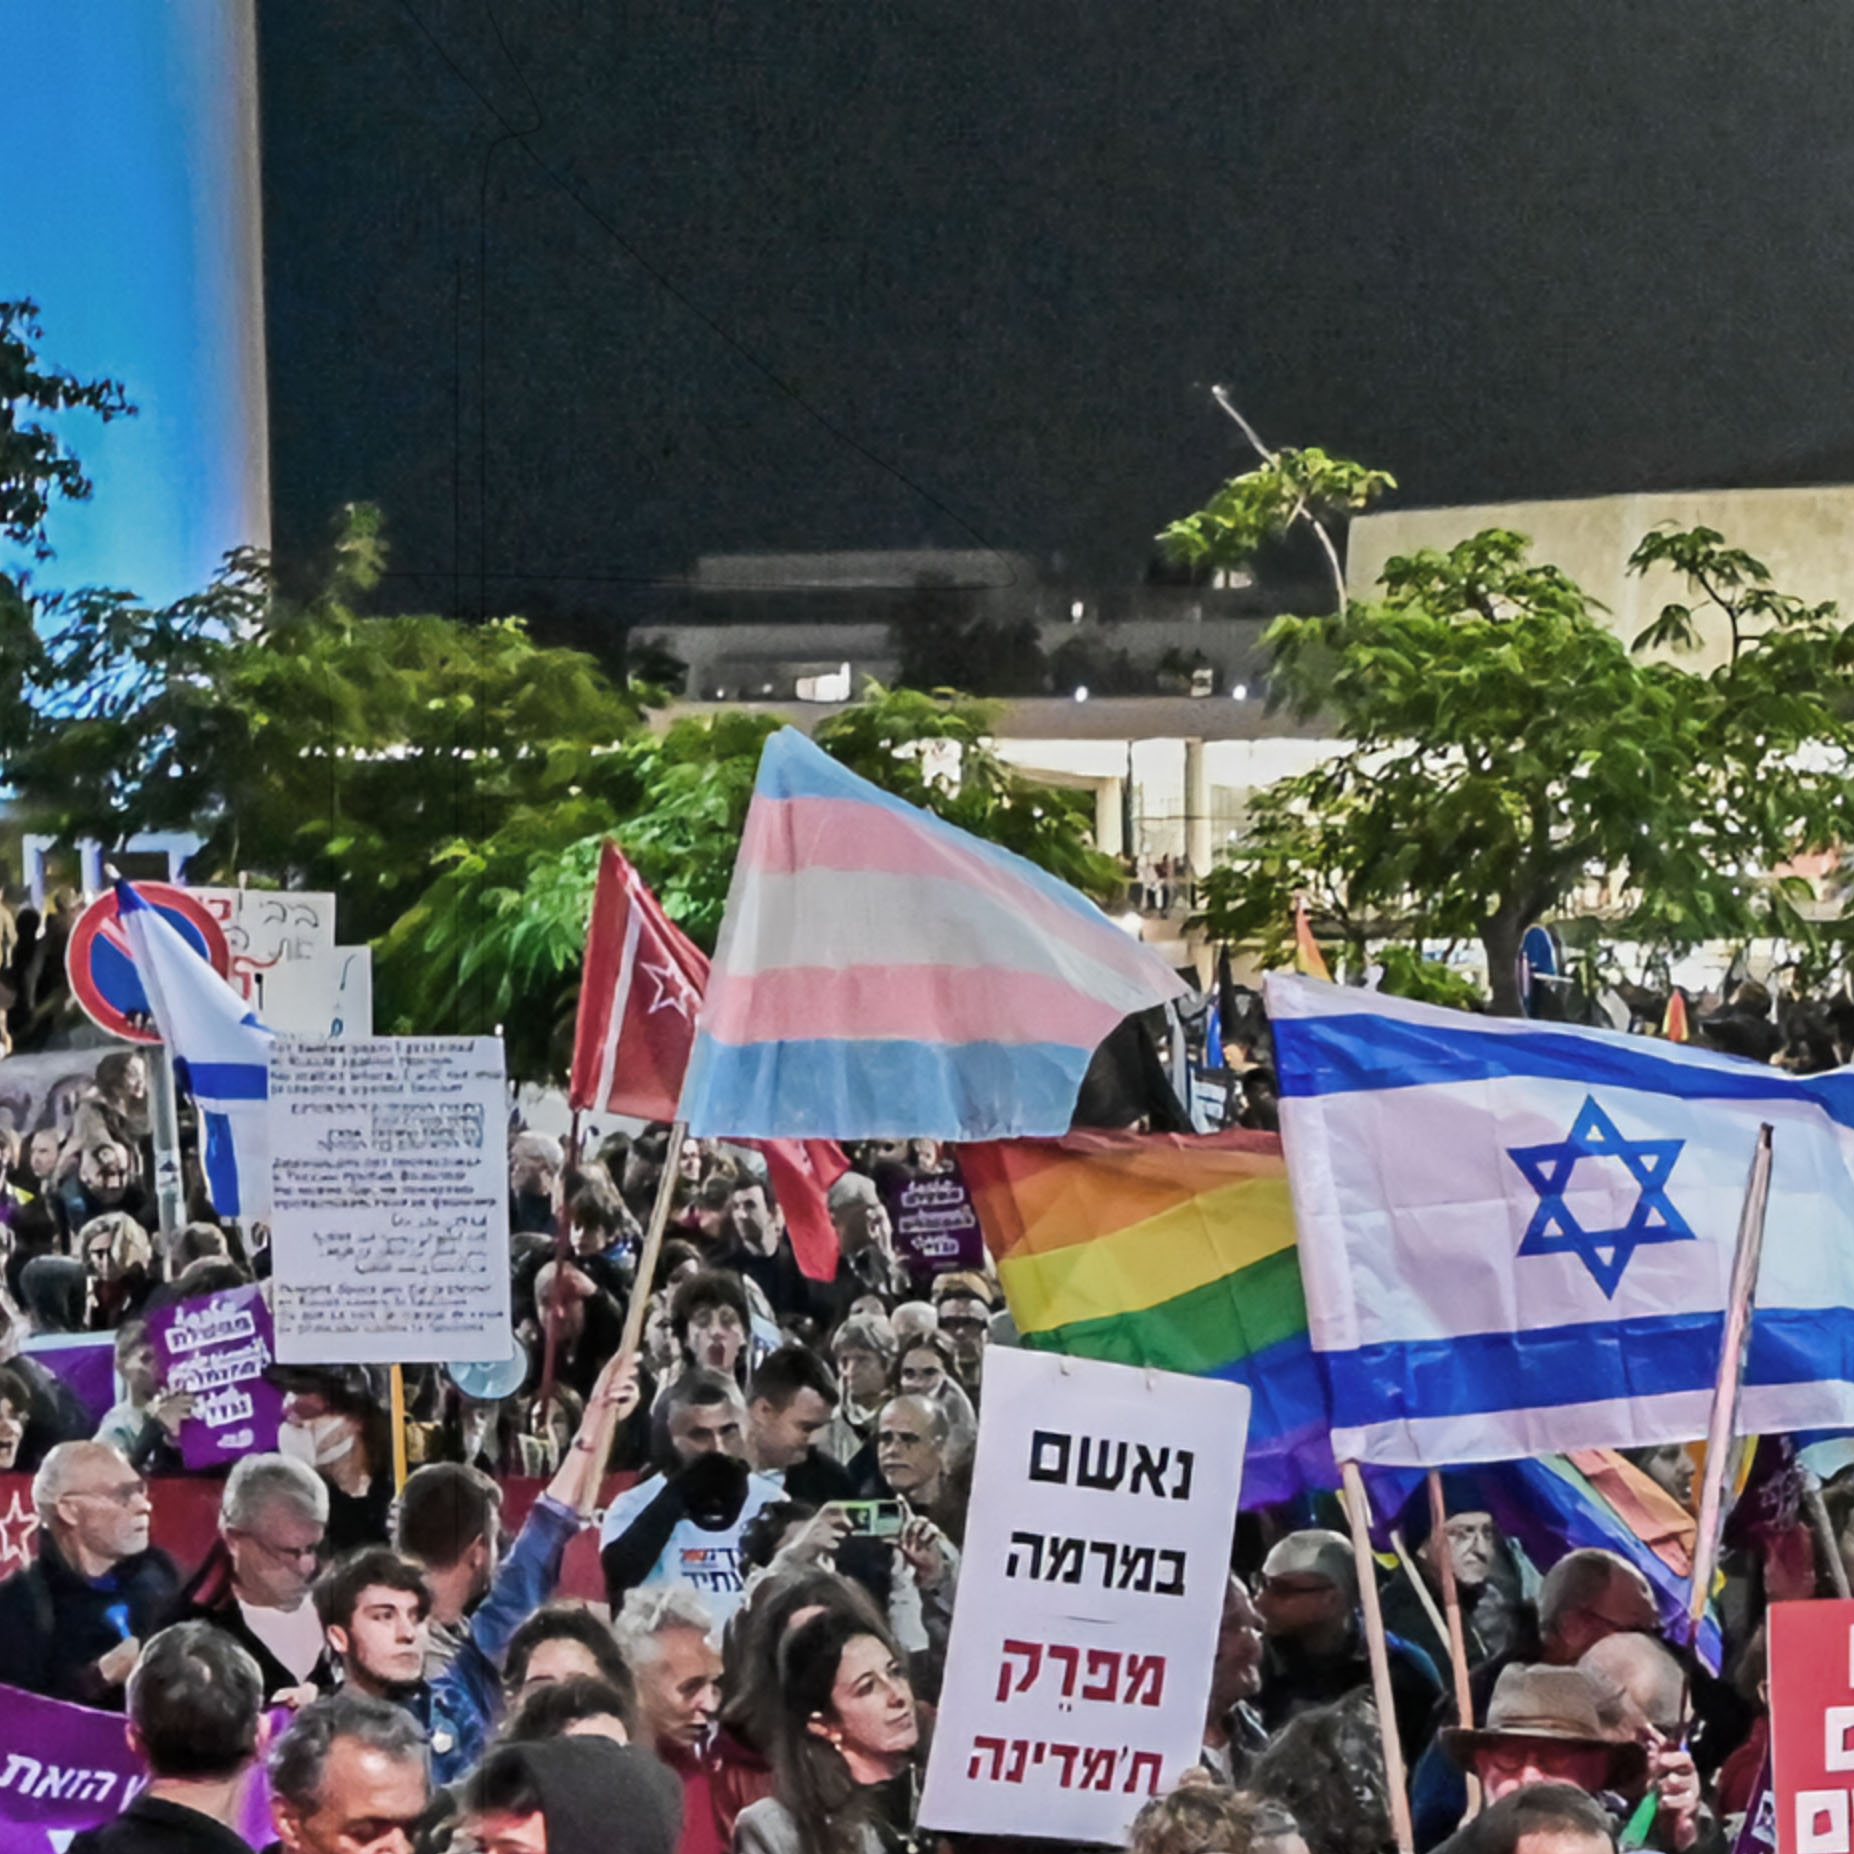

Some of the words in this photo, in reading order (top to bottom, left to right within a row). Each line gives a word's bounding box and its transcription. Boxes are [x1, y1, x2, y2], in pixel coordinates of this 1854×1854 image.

[1029, 1430, 1195, 1500] נאשם
[1006, 1531, 1187, 1597] במרמה
[0, 1753, 118, 1803] הזאת
